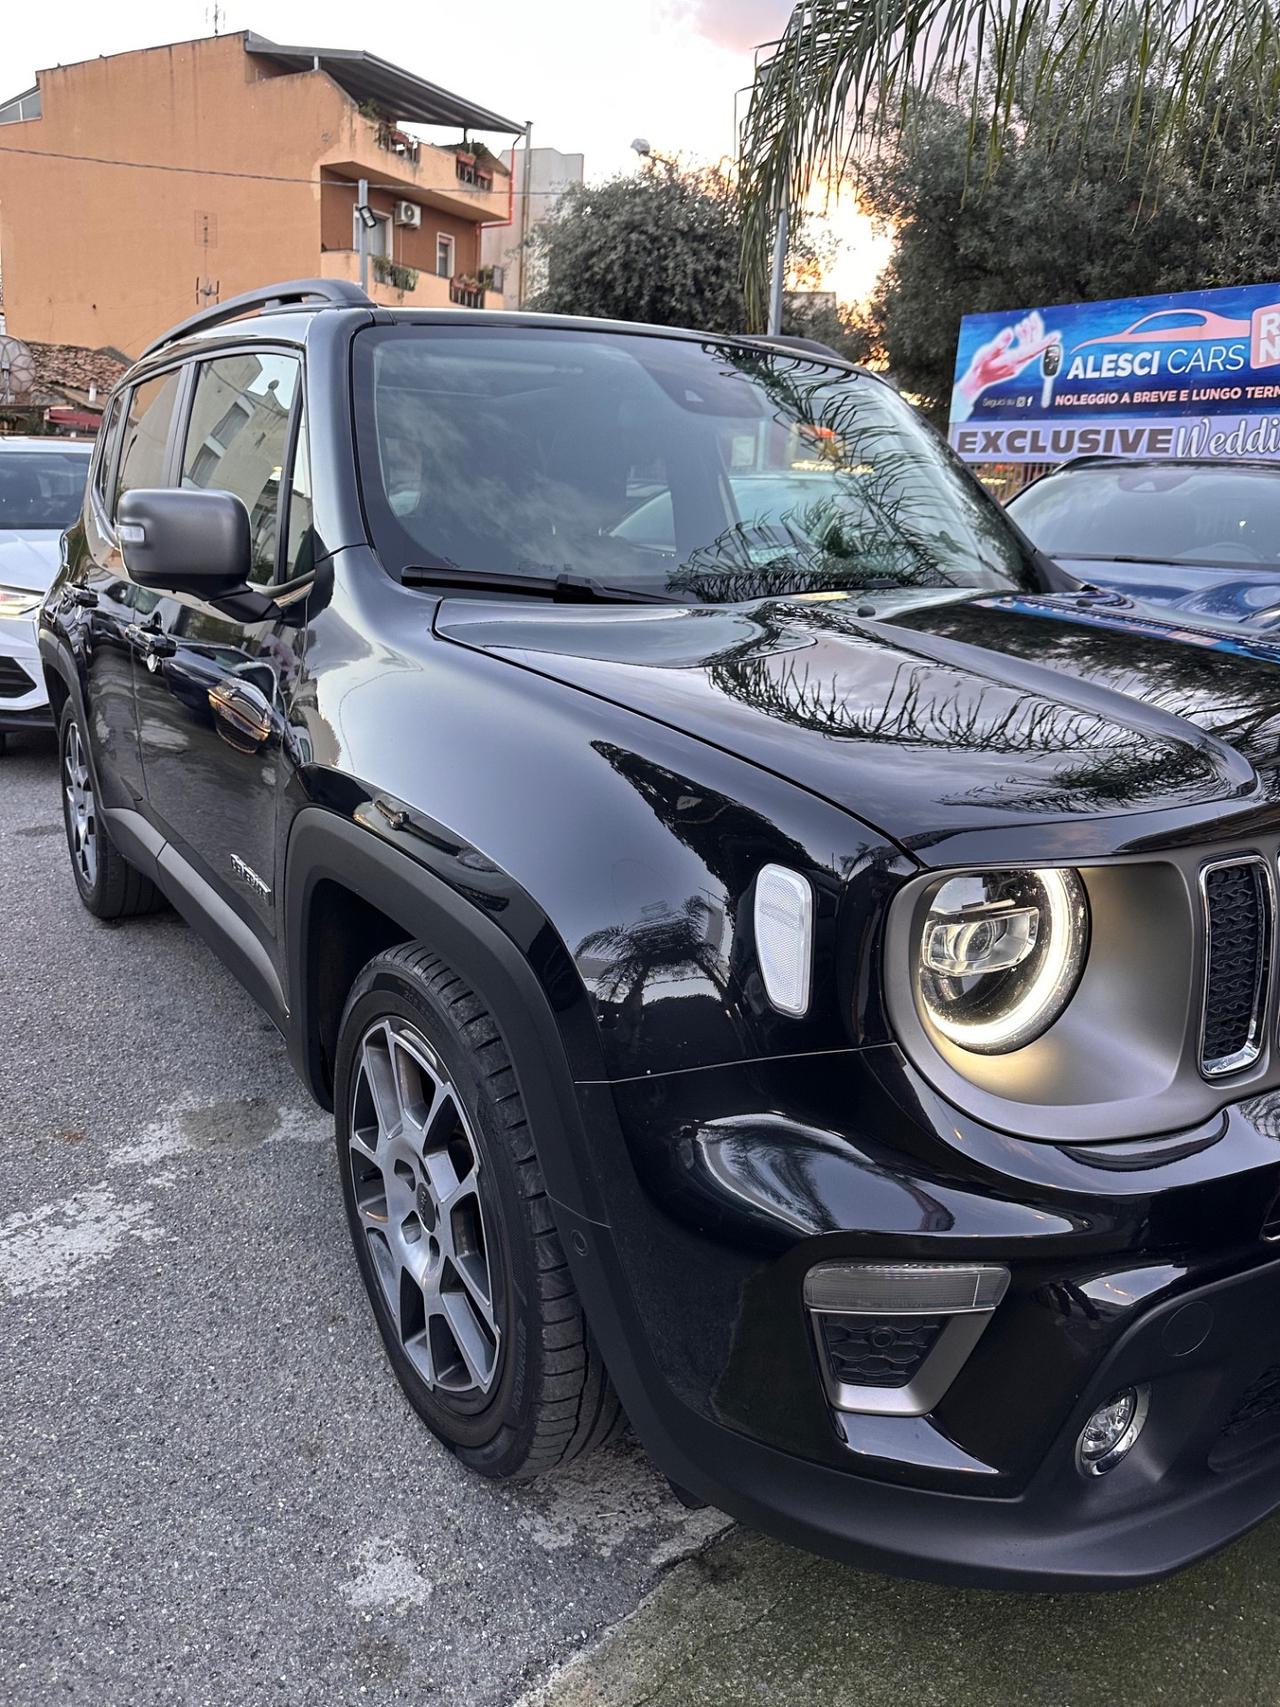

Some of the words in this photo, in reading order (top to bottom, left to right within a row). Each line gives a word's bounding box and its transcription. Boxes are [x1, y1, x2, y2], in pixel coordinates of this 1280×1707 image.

[1066, 351, 1161, 379] ALESCI
[1167, 344, 1246, 374] CARS
[1055, 391, 1118, 406] NOLEGGIO
[1120, 392, 1130, 404] A
[1132, 389, 1178, 403] BREVE
[1179, 389, 1189, 401] E
[1191, 386, 1242, 401] LUNGO
[956, 427, 1174, 455] EXCLUSIVE
[1176, 415, 1280, 458] Weddi
